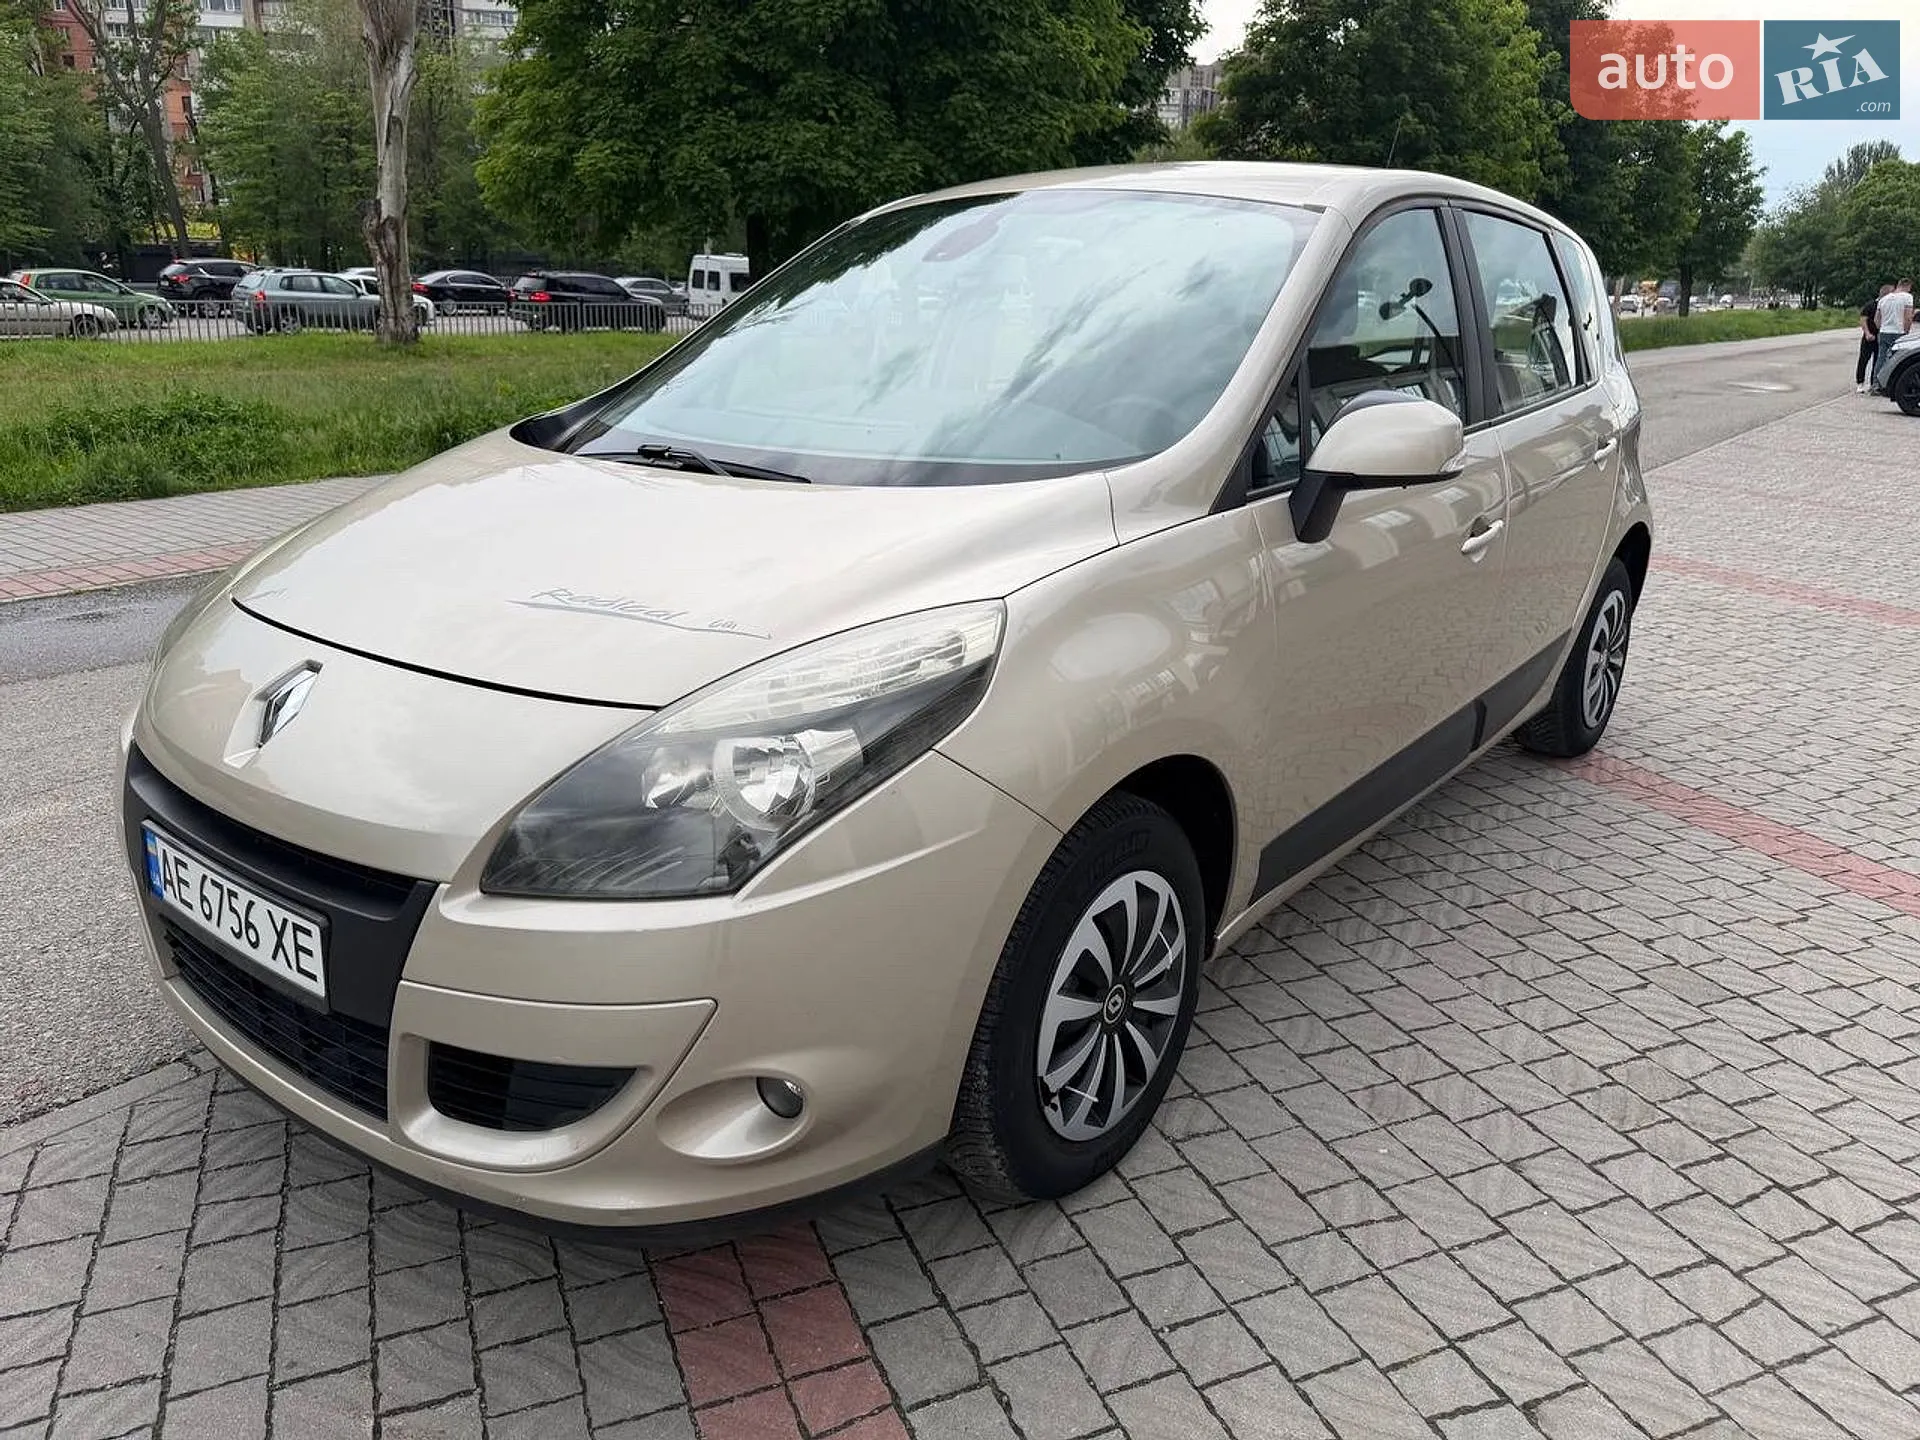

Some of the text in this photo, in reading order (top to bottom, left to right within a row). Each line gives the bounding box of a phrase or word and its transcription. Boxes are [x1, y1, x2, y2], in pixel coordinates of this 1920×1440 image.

[162, 849, 318, 983] AE 6756 XE
